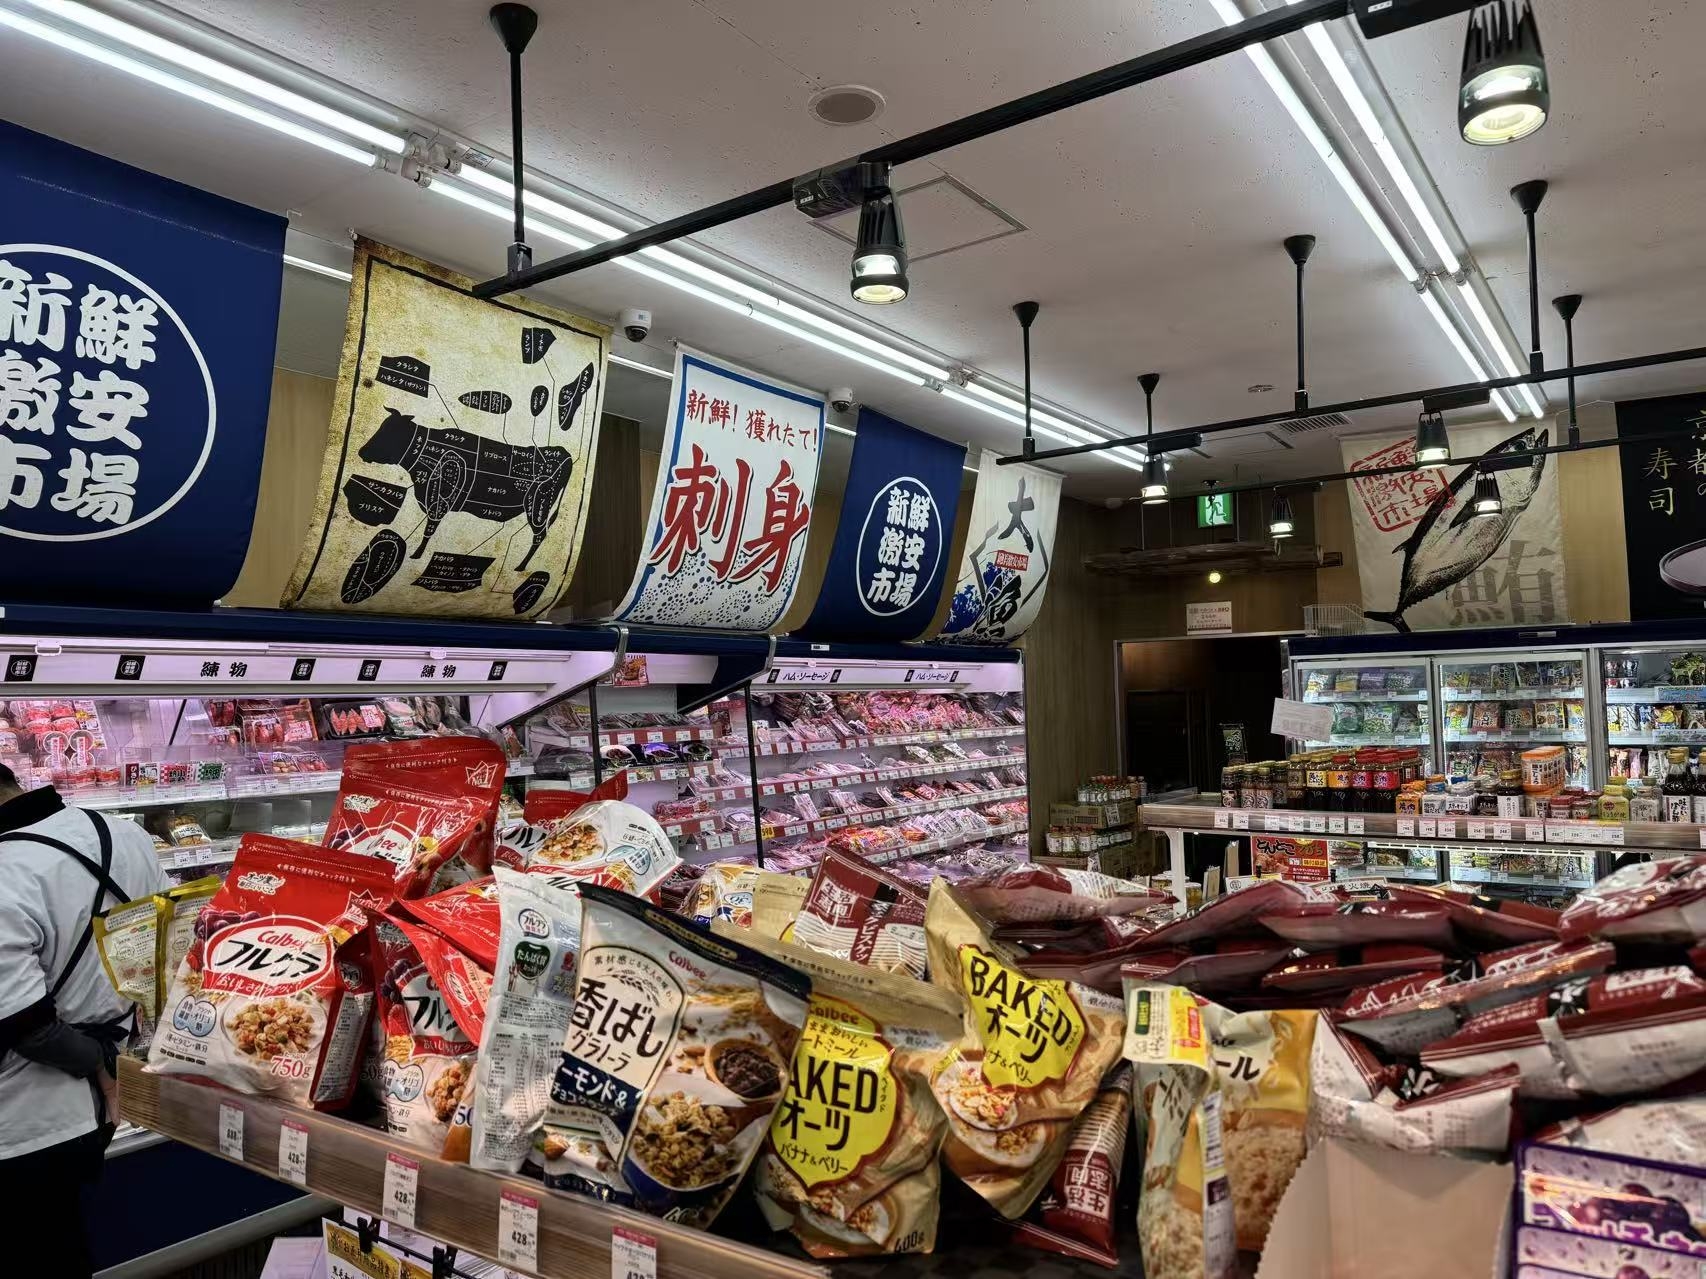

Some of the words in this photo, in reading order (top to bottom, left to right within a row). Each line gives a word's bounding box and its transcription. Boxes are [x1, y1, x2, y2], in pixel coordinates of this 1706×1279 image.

[1643, 447, 1677, 516] 寿司
[650, 443, 811, 593] 刺身
[887, 486, 931, 532] 新鮮
[878, 526, 926, 571] 激安
[867, 567, 918, 607] 市場
[783, 672, 830, 681] ハム・ソーセージ
[668, 950, 707, 980] Calbee
[571, 977, 663, 1057] 香ばし
[970, 956, 1072, 1047] BAKED
[571, 1030, 632, 1072] グラノーラ
[986, 1004, 1048, 1064] オーツ
[271, 1056, 312, 1079] 750g
[987, 1049, 1033, 1085] ナ&ベリー
[780, 1098, 851, 1151] オーツ
[288, 1152, 300, 1164] 428
[394, 1190, 408, 1204] 428
[511, 1231, 528, 1246] 428
